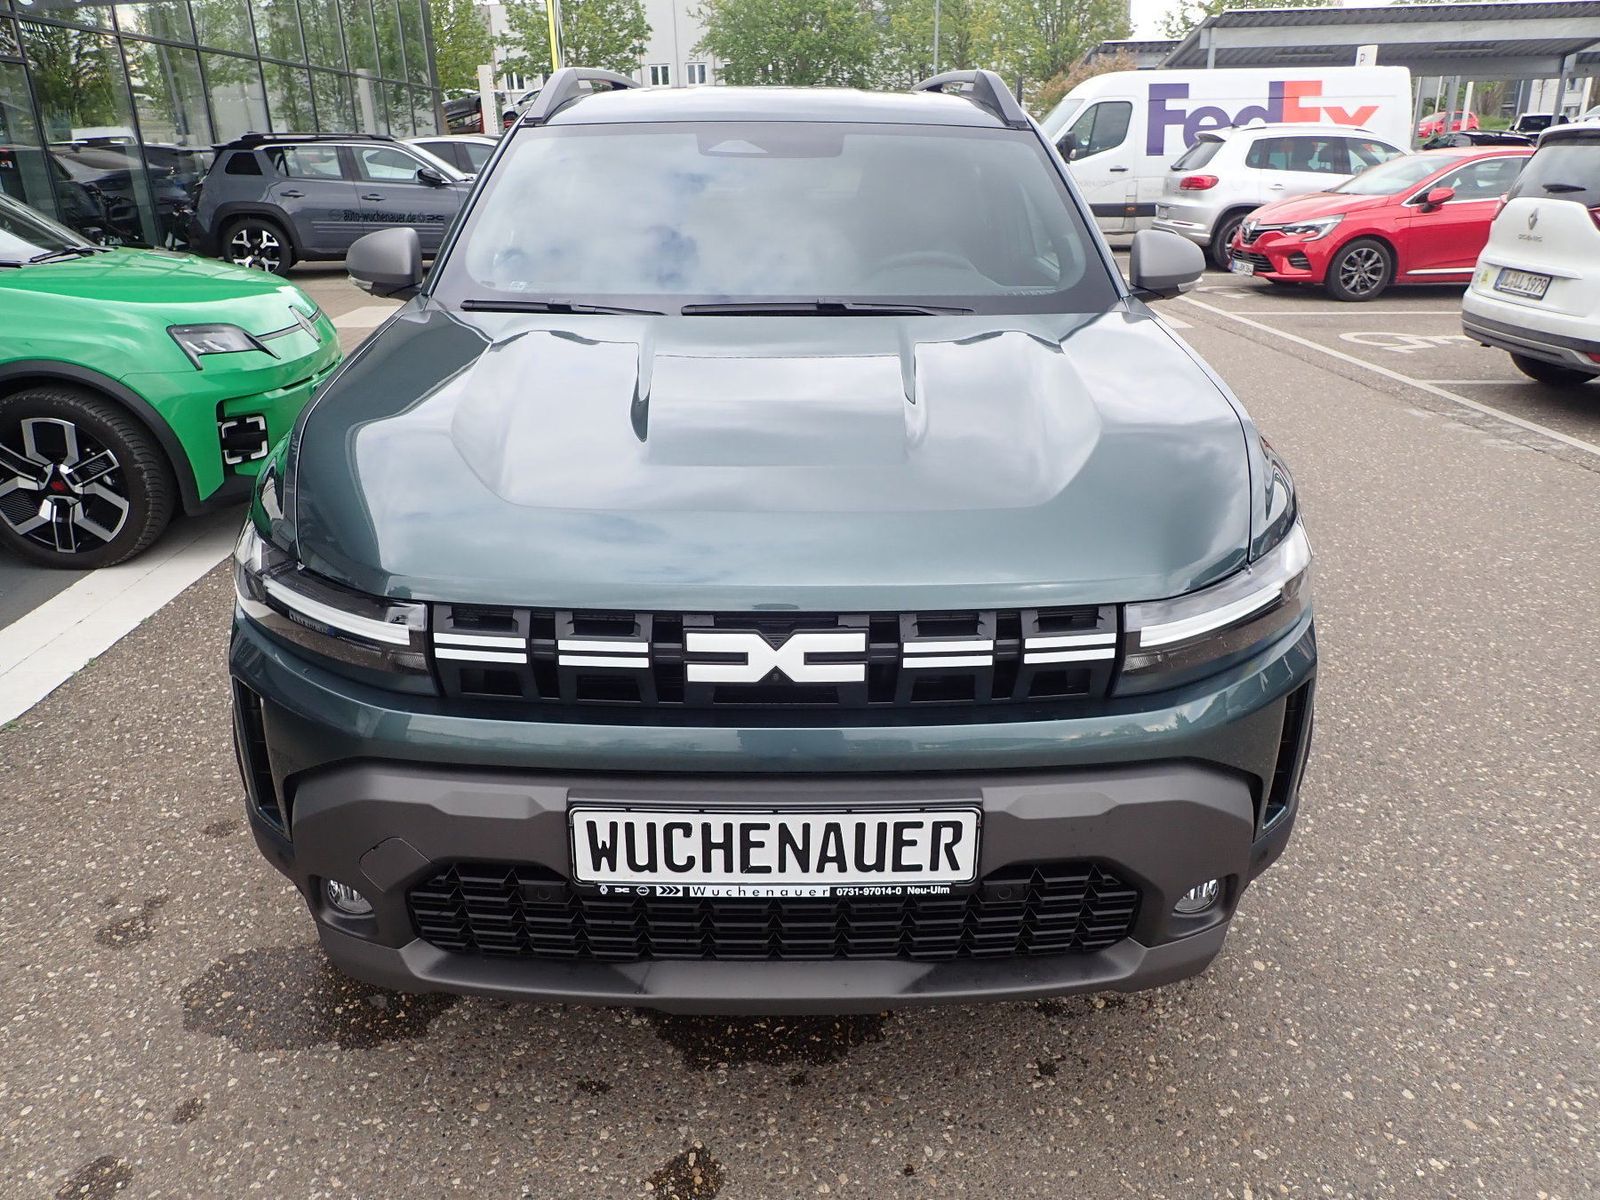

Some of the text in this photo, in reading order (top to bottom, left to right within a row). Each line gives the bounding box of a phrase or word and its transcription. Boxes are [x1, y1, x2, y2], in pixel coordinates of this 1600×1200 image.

[343, 209, 417, 222] auto-wuchenauer.de
[1523, 276, 1548, 293] 1979
[586, 820, 964, 873] WUCHENAUER
[692, 884, 950, 897] Wuchenauer 0731-97014-0 Neu-Ulm
